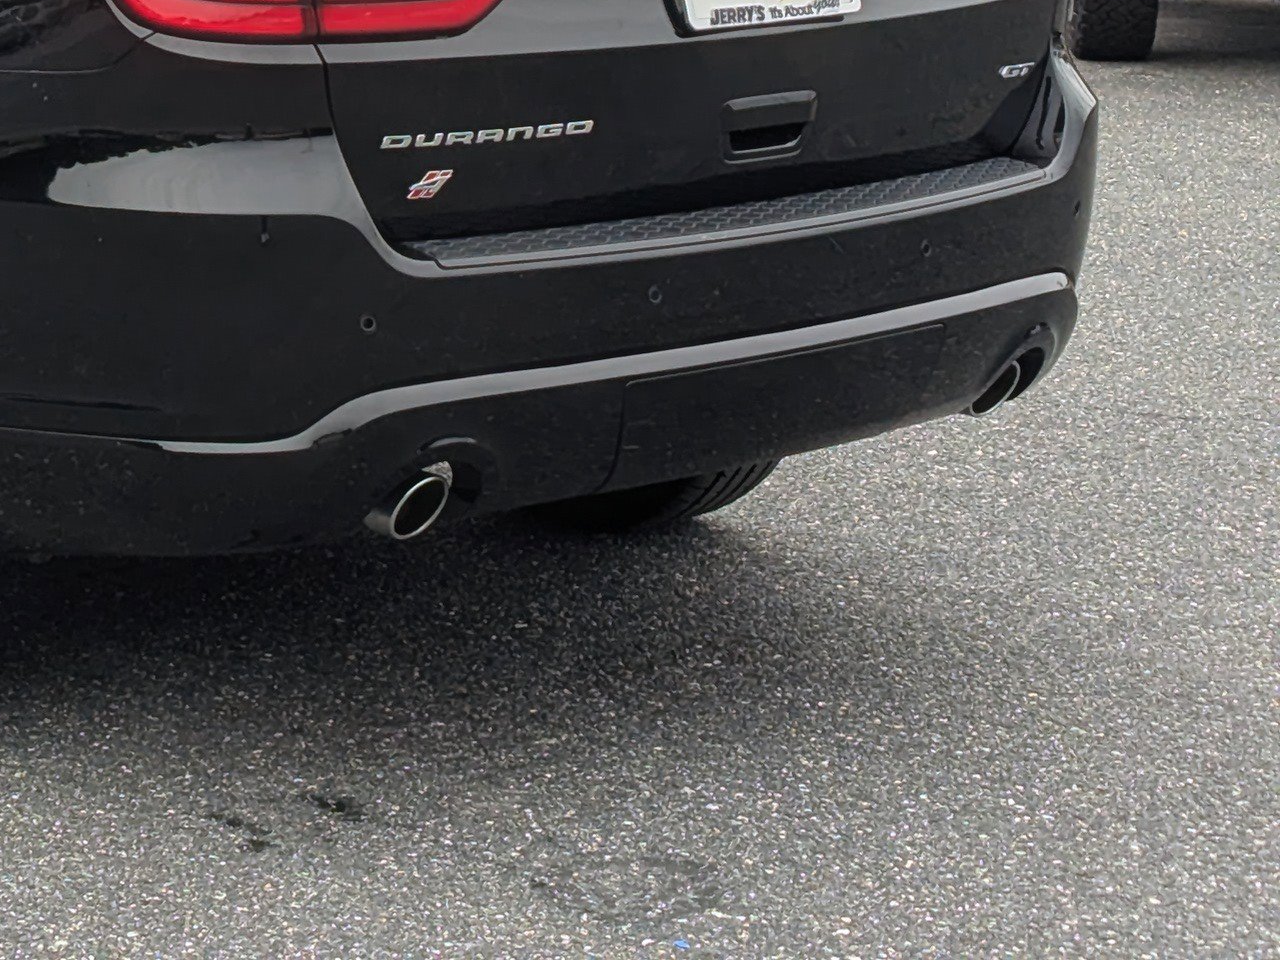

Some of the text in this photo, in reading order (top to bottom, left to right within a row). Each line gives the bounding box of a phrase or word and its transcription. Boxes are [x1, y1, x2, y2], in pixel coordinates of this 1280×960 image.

[710, 5, 766, 25] JERRY'S
[784, 5, 814, 17] About
[379, 119, 594, 149] DURANGO
